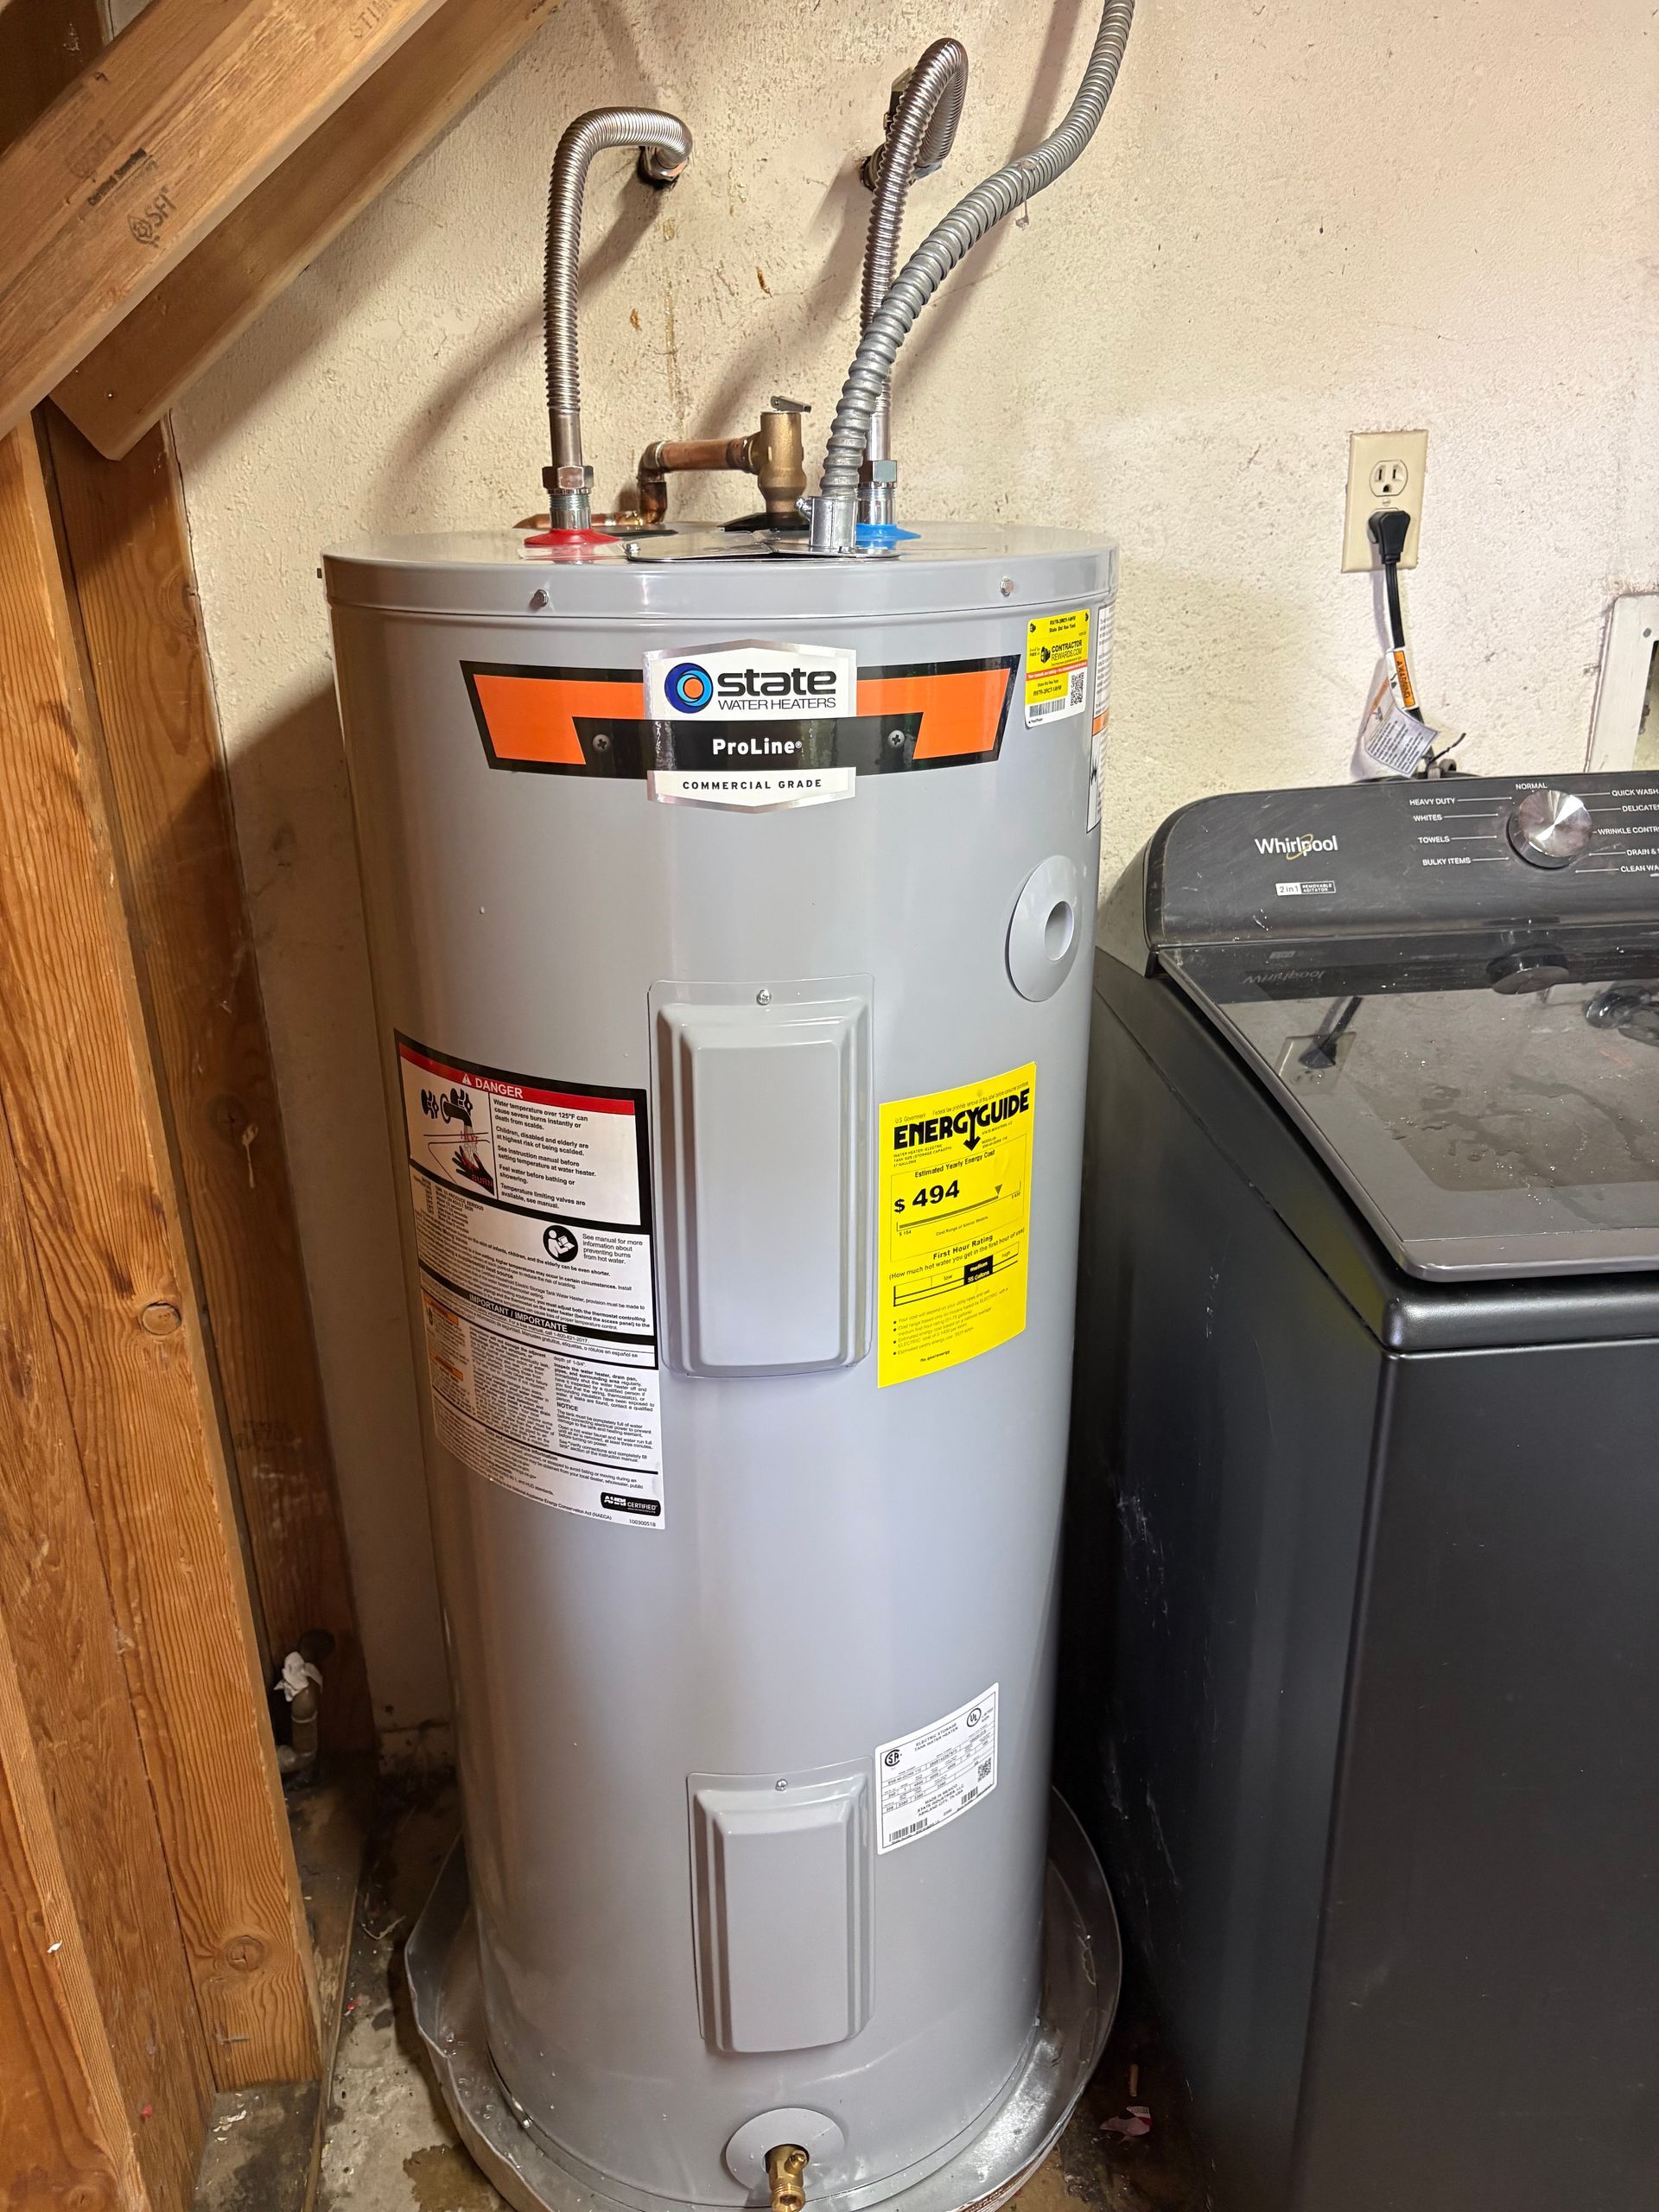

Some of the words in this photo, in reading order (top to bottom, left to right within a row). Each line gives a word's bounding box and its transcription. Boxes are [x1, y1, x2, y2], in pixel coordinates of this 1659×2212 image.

[1052, 639, 1082, 652] CONTRACTOR
[717, 668, 836, 696] state
[718, 699, 769, 710] WATER
[772, 697, 836, 709] HEATERS
[683, 781, 771, 790] COMMERCIAL
[779, 779, 822, 789] GRADE
[1255, 836, 1338, 856] Whirlpool
[475, 1077, 524, 1098] DANGER
[510, 1103, 543, 1115] temperature
[548, 1119, 573, 1128] instantly
[894, 1088, 1030, 1150] ENERGYGUIDE
[904, 1113, 925, 1122] Government
[524, 1122, 544, 1130] scalds.
[496, 1126, 519, 1137] Children,
[521, 1132, 543, 1142] disabled
[557, 1140, 577, 1149] elderly
[503, 1135, 522, 1145] highest
[499, 1154, 516, 1162] setting
[517, 1159, 550, 1169] temperature
[508, 1147, 537, 1160] instruction
[560, 1158, 579, 1166] before
[915, 1166, 944, 1178] Estimated
[946, 1160, 963, 1170] Yearly
[965, 1154, 982, 1165] Energy
[472, 1174, 493, 1187] BURN
[500, 1173, 528, 1184] showering.
[527, 1171, 544, 1179] before
[545, 1175, 567, 1185] bathing
[500, 1183, 533, 1196] Temperature
[534, 1192, 555, 1201] limiting
[556, 1196, 575, 1205] valves
[501, 1191, 525, 1202] available,
[537, 1200, 559, 1209] manual.
[894, 1198, 905, 1213] $
[912, 1179, 959, 1207] 494
[583, 1241, 614, 1249] information
[933, 1250, 950, 1260] First
[953, 1244, 969, 1254] Hour
[972, 1235, 994, 1248] Rating
[583, 1248, 613, 1257] preventing
[889, 1270, 905, 1281] (How
[906, 1266, 924, 1275] much
[936, 1257, 951, 1268] water
[952, 1255, 963, 1263] you
[964, 1250, 973, 1260] get
[988, 1241, 999, 1250] first
[999, 1236, 1010, 1245] hour
[970, 1262, 988, 1272] medium
[581, 1280, 617, 1289] circumstances.
[469, 1293, 509, 1315] IMPORTANT
[515, 1312, 568, 1332] IMPORTANTE
[557, 1402, 578, 1411] NOTICE
